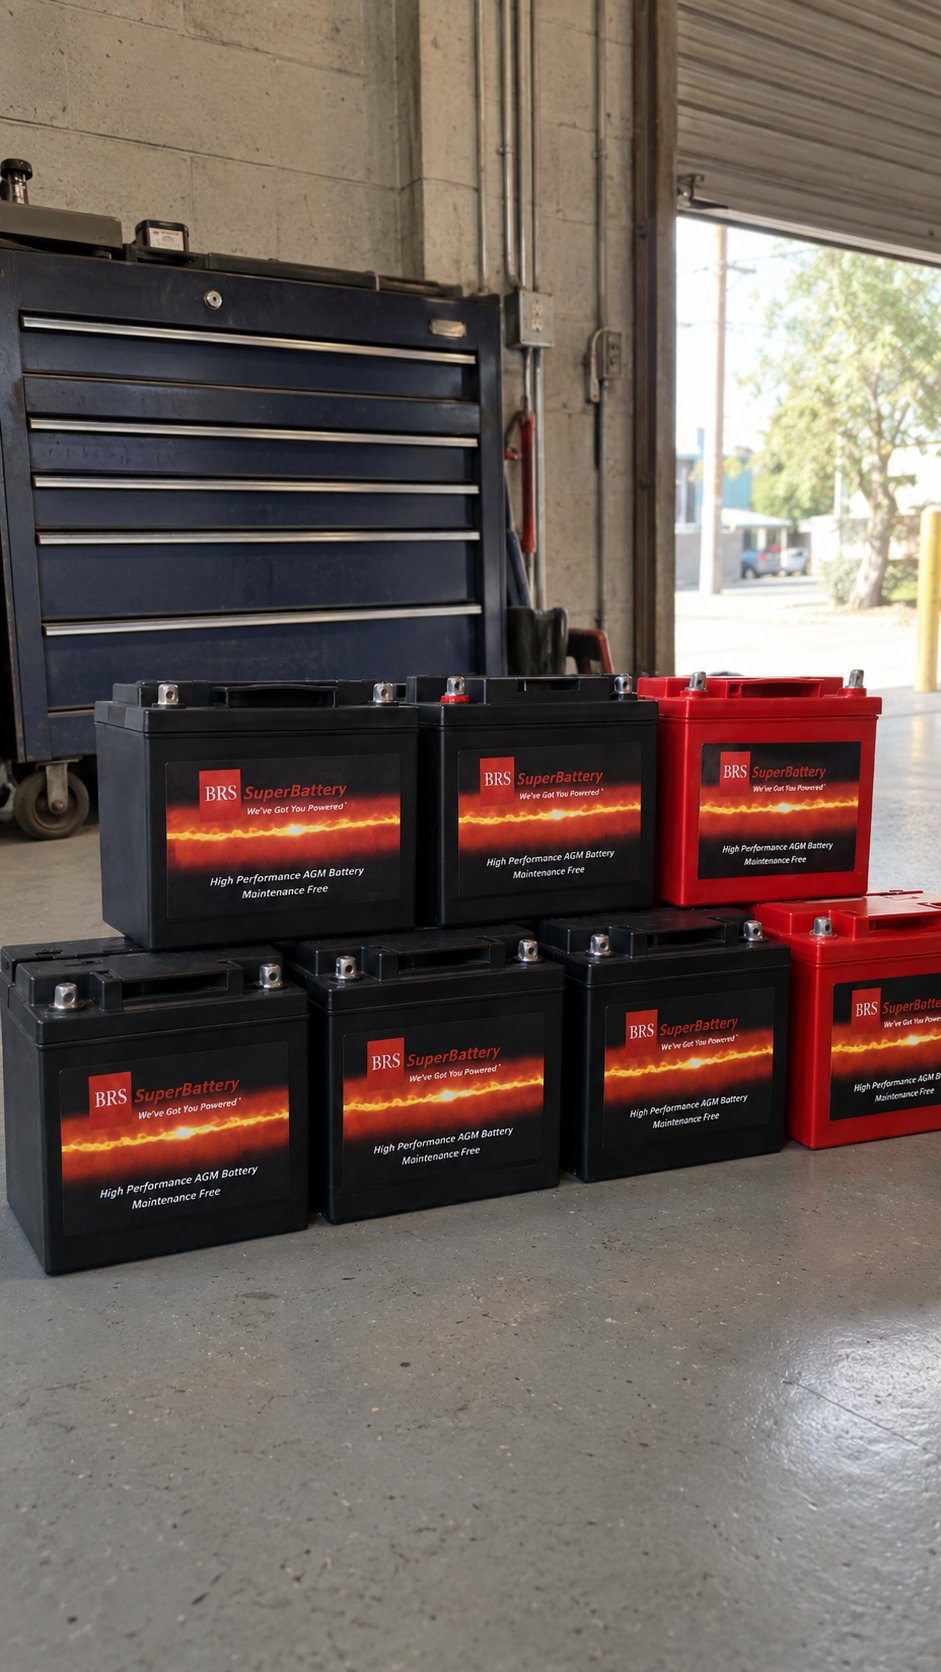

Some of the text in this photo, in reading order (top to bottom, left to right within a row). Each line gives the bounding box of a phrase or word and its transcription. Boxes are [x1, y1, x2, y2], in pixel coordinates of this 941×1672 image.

[484, 771, 603, 787] BRS SuperBattery
[724, 765, 826, 780] BRS SuperBattery
[205, 784, 347, 802] BRS SuperBattery
[542, 791, 555, 799] Got
[274, 806, 289, 814] Got
[291, 805, 306, 813] You
[722, 846, 739, 855] High
[741, 844, 788, 853] Performance
[808, 842, 833, 850] Battery
[487, 850, 615, 867] High Performance AGM Battery
[744, 857, 790, 866] Maintenance
[210, 867, 364, 888] High Performance AGM Battery
[513, 866, 585, 879] Maintenance Free
[242, 885, 329, 899] Maintenance Free
[856, 1002, 878, 1017] BRS
[630, 1018, 738, 1039] BRS SuperBattery
[372, 1047, 500, 1071] BRS SuperBattery
[449, 1070, 463, 1078] You
[854, 1083, 871, 1093] High
[872, 1076, 916, 1090] Performance
[918, 1073, 934, 1082] AGM
[95, 1079, 240, 1108] BRS SuperBattery
[875, 1087, 935, 1102] Maintenance Free
[166, 1107, 181, 1116] Got
[183, 1104, 198, 1113] You
[630, 1094, 748, 1119] High Performance AGM Battery
[653, 1112, 720, 1129] Maintenance Free
[374, 1127, 514, 1155] High Performance AGM Battery
[402, 1147, 481, 1165] Maintenance Free
[100, 1165, 258, 1200] High Performance AGM Battery
[132, 1187, 221, 1209] Maintenance Free
